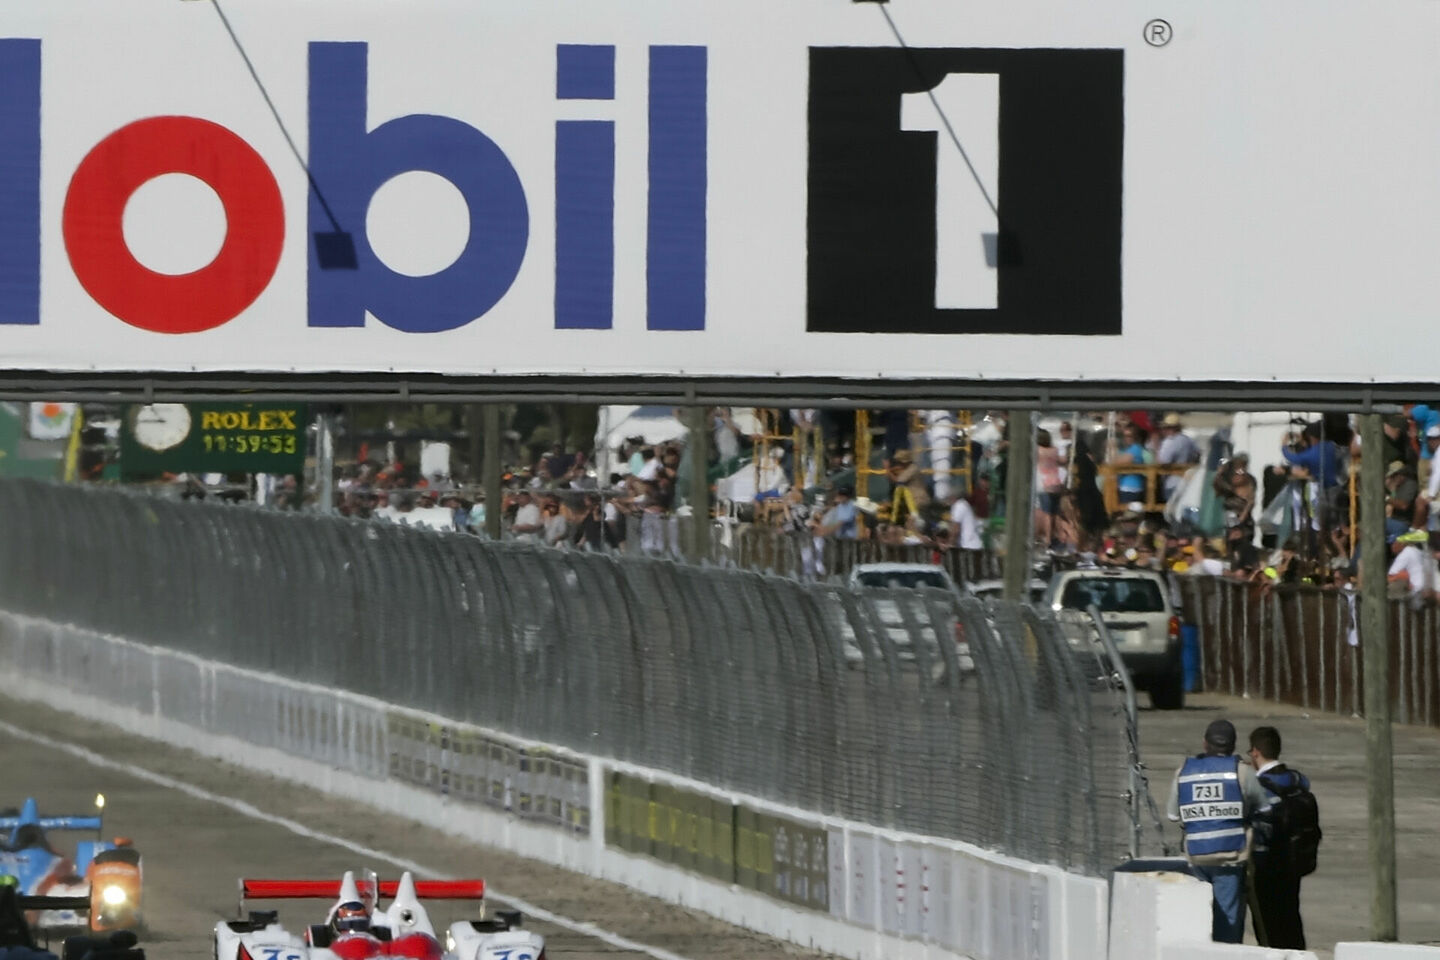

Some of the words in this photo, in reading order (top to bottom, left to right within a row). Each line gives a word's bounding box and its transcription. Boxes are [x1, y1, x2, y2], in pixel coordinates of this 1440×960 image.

[202, 410, 297, 431] ROLEX
[203, 434, 297, 454] 11:59:53
[1195, 786, 1221, 798] 731
[1209, 805, 1240, 817] Photo
